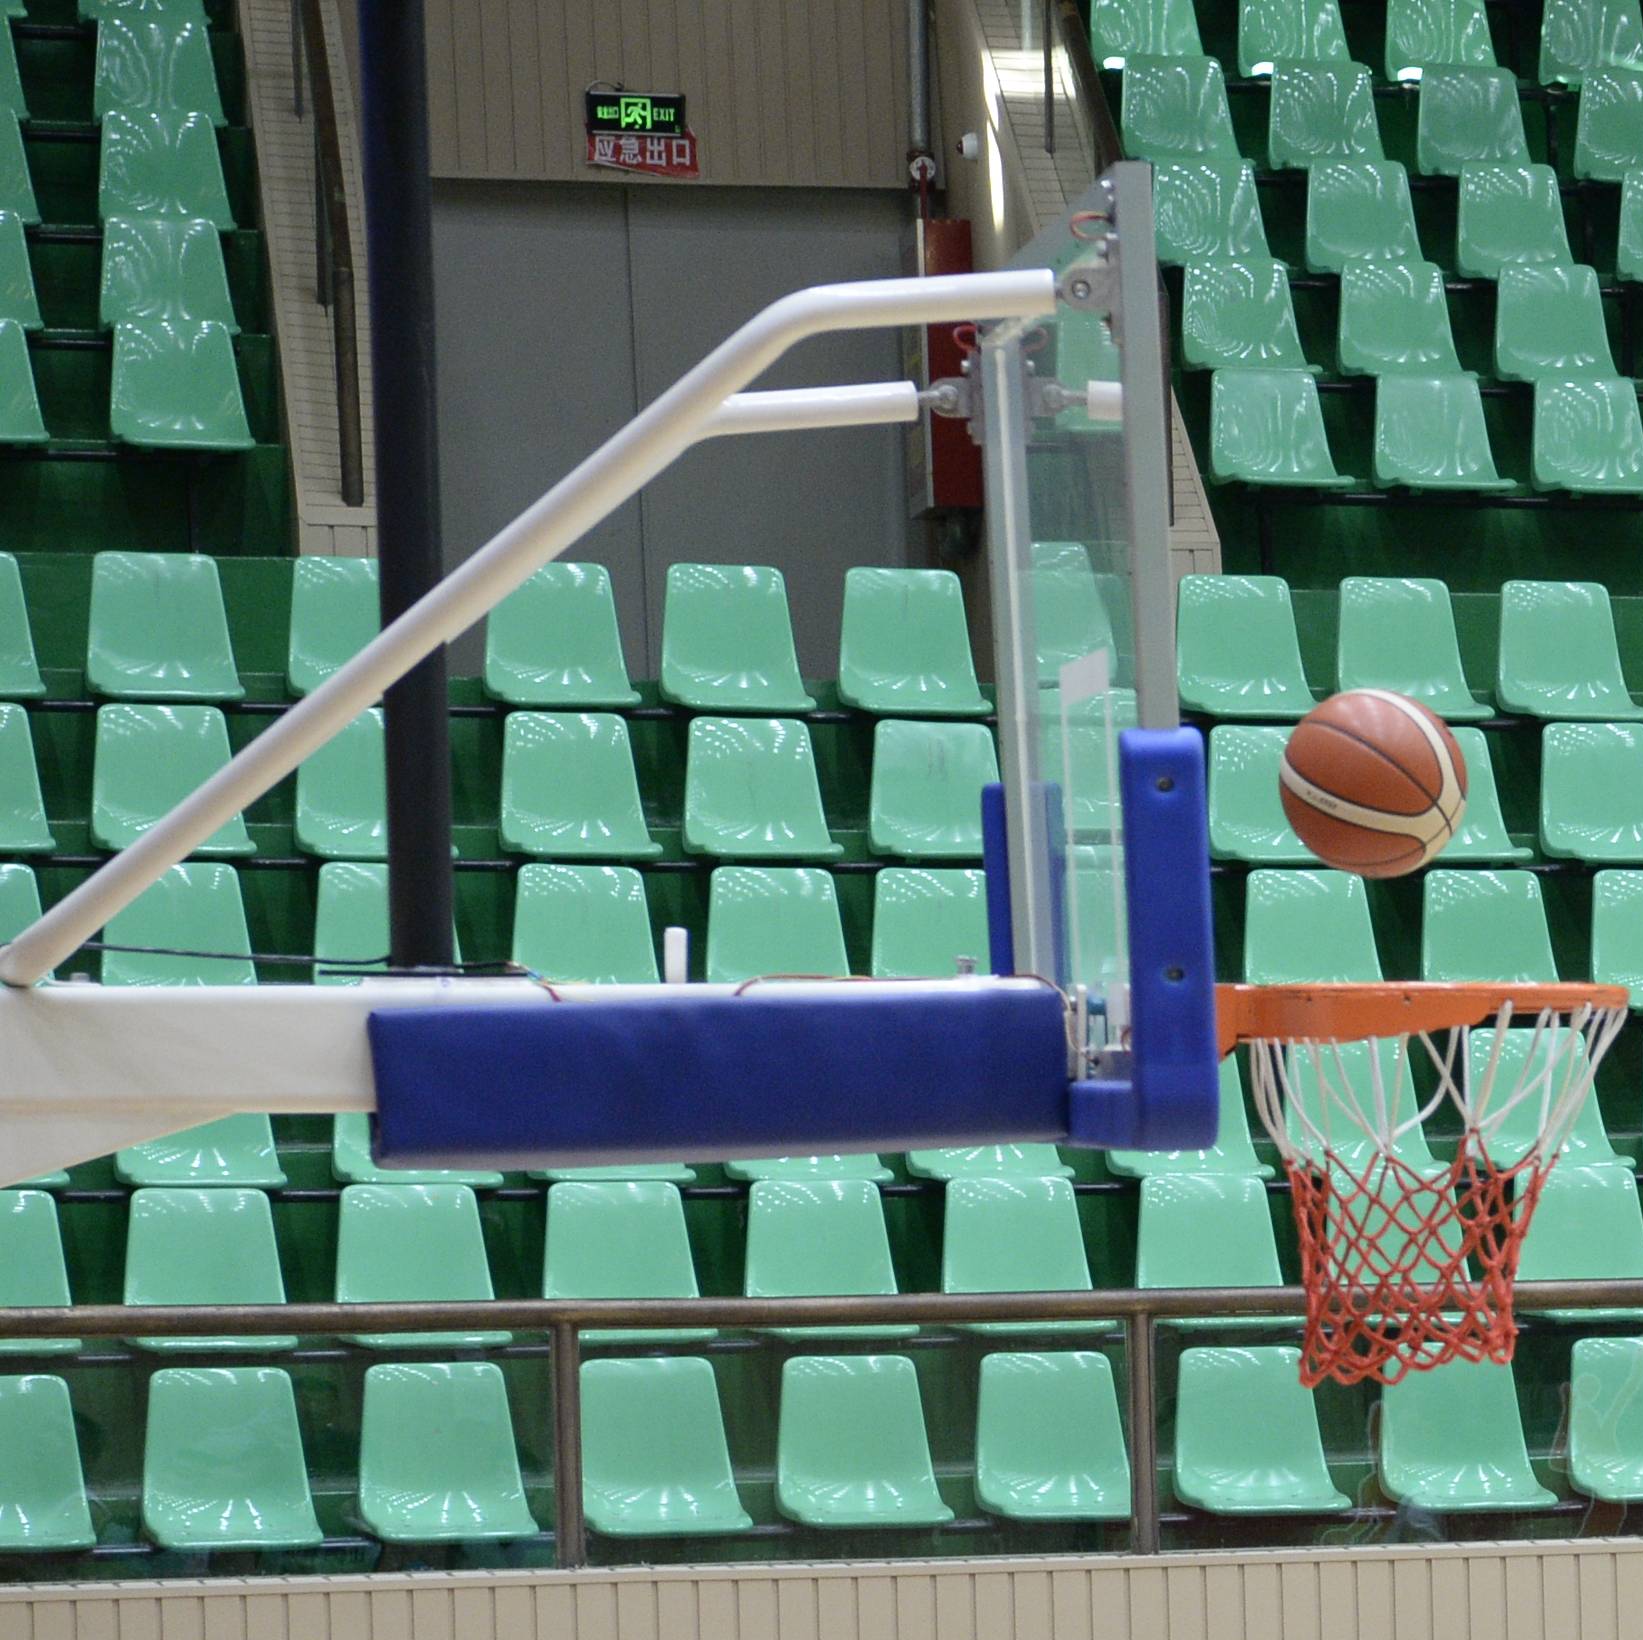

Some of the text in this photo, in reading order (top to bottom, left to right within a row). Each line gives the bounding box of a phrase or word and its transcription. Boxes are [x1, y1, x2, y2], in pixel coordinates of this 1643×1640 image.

[653, 108, 675, 121] EXIT
[594, 136, 690, 166] 应急出口
